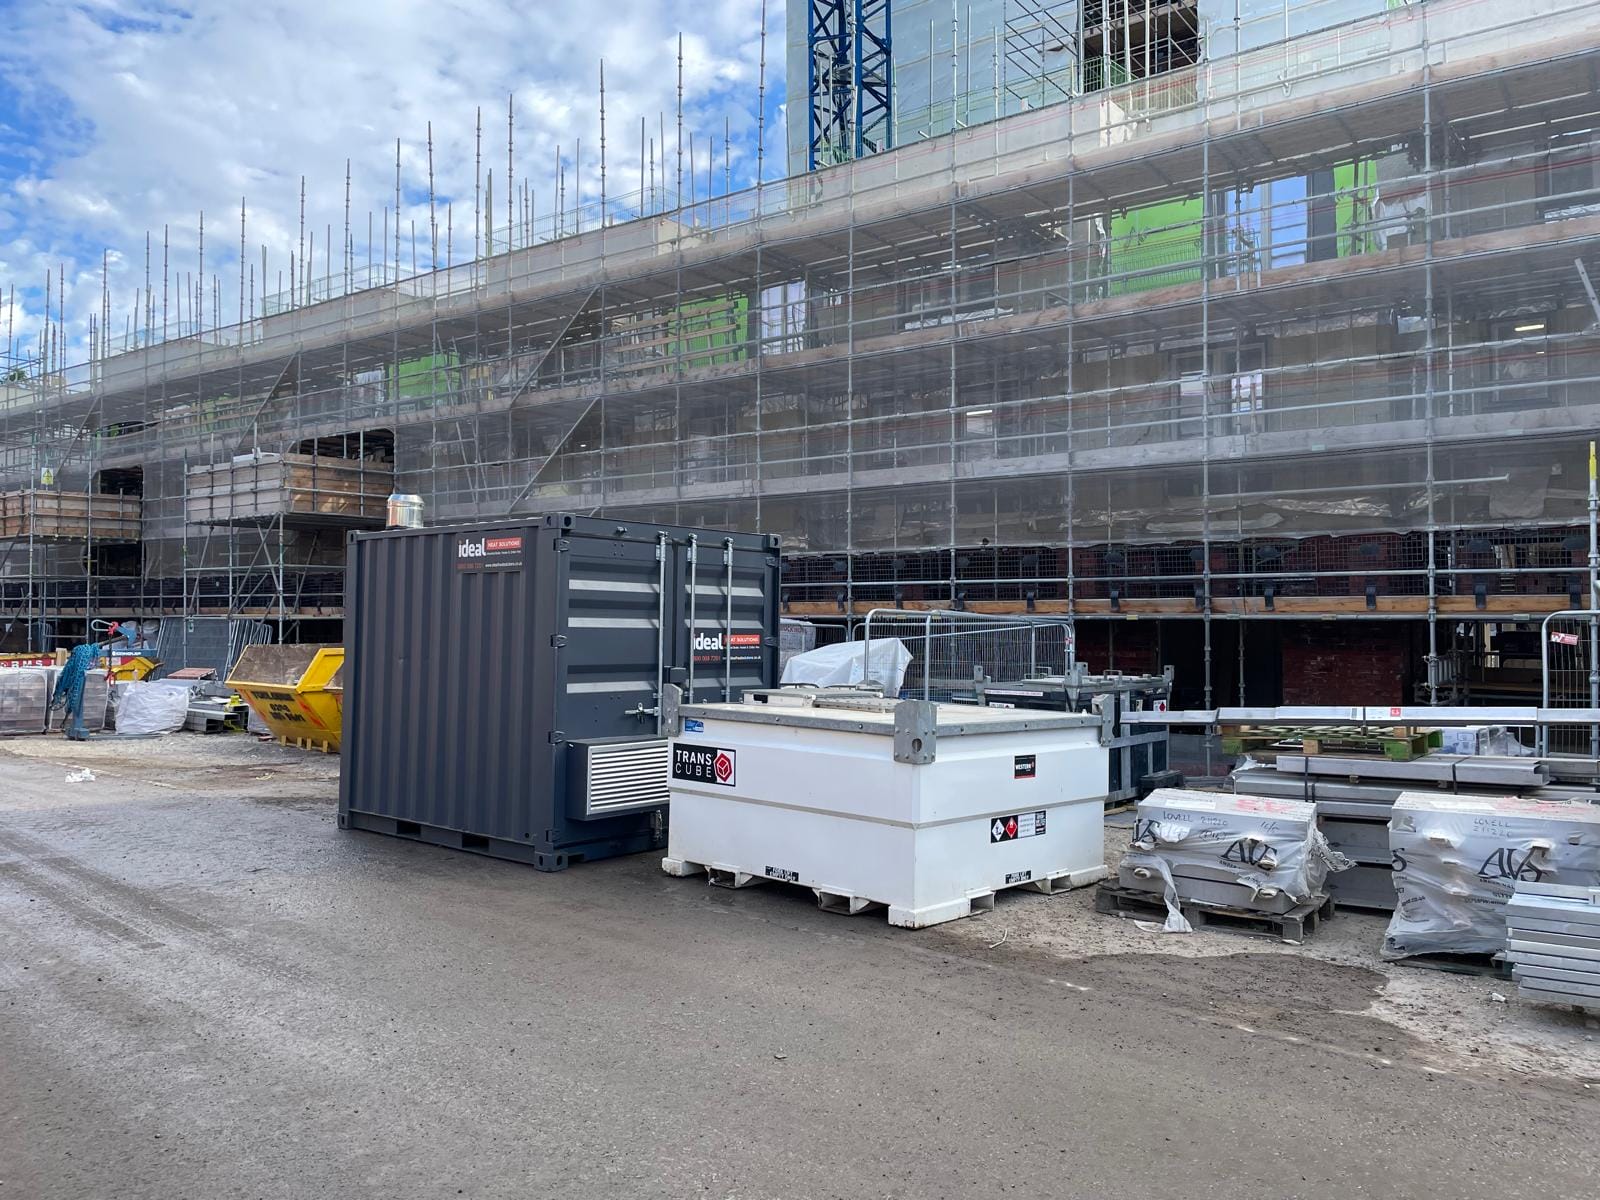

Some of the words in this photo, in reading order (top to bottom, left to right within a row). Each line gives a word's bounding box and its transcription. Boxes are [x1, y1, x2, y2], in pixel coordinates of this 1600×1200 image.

[458, 537, 487, 558] ideal
[676, 750, 712, 766] TRANS
[675, 763, 712, 778] CUBE
